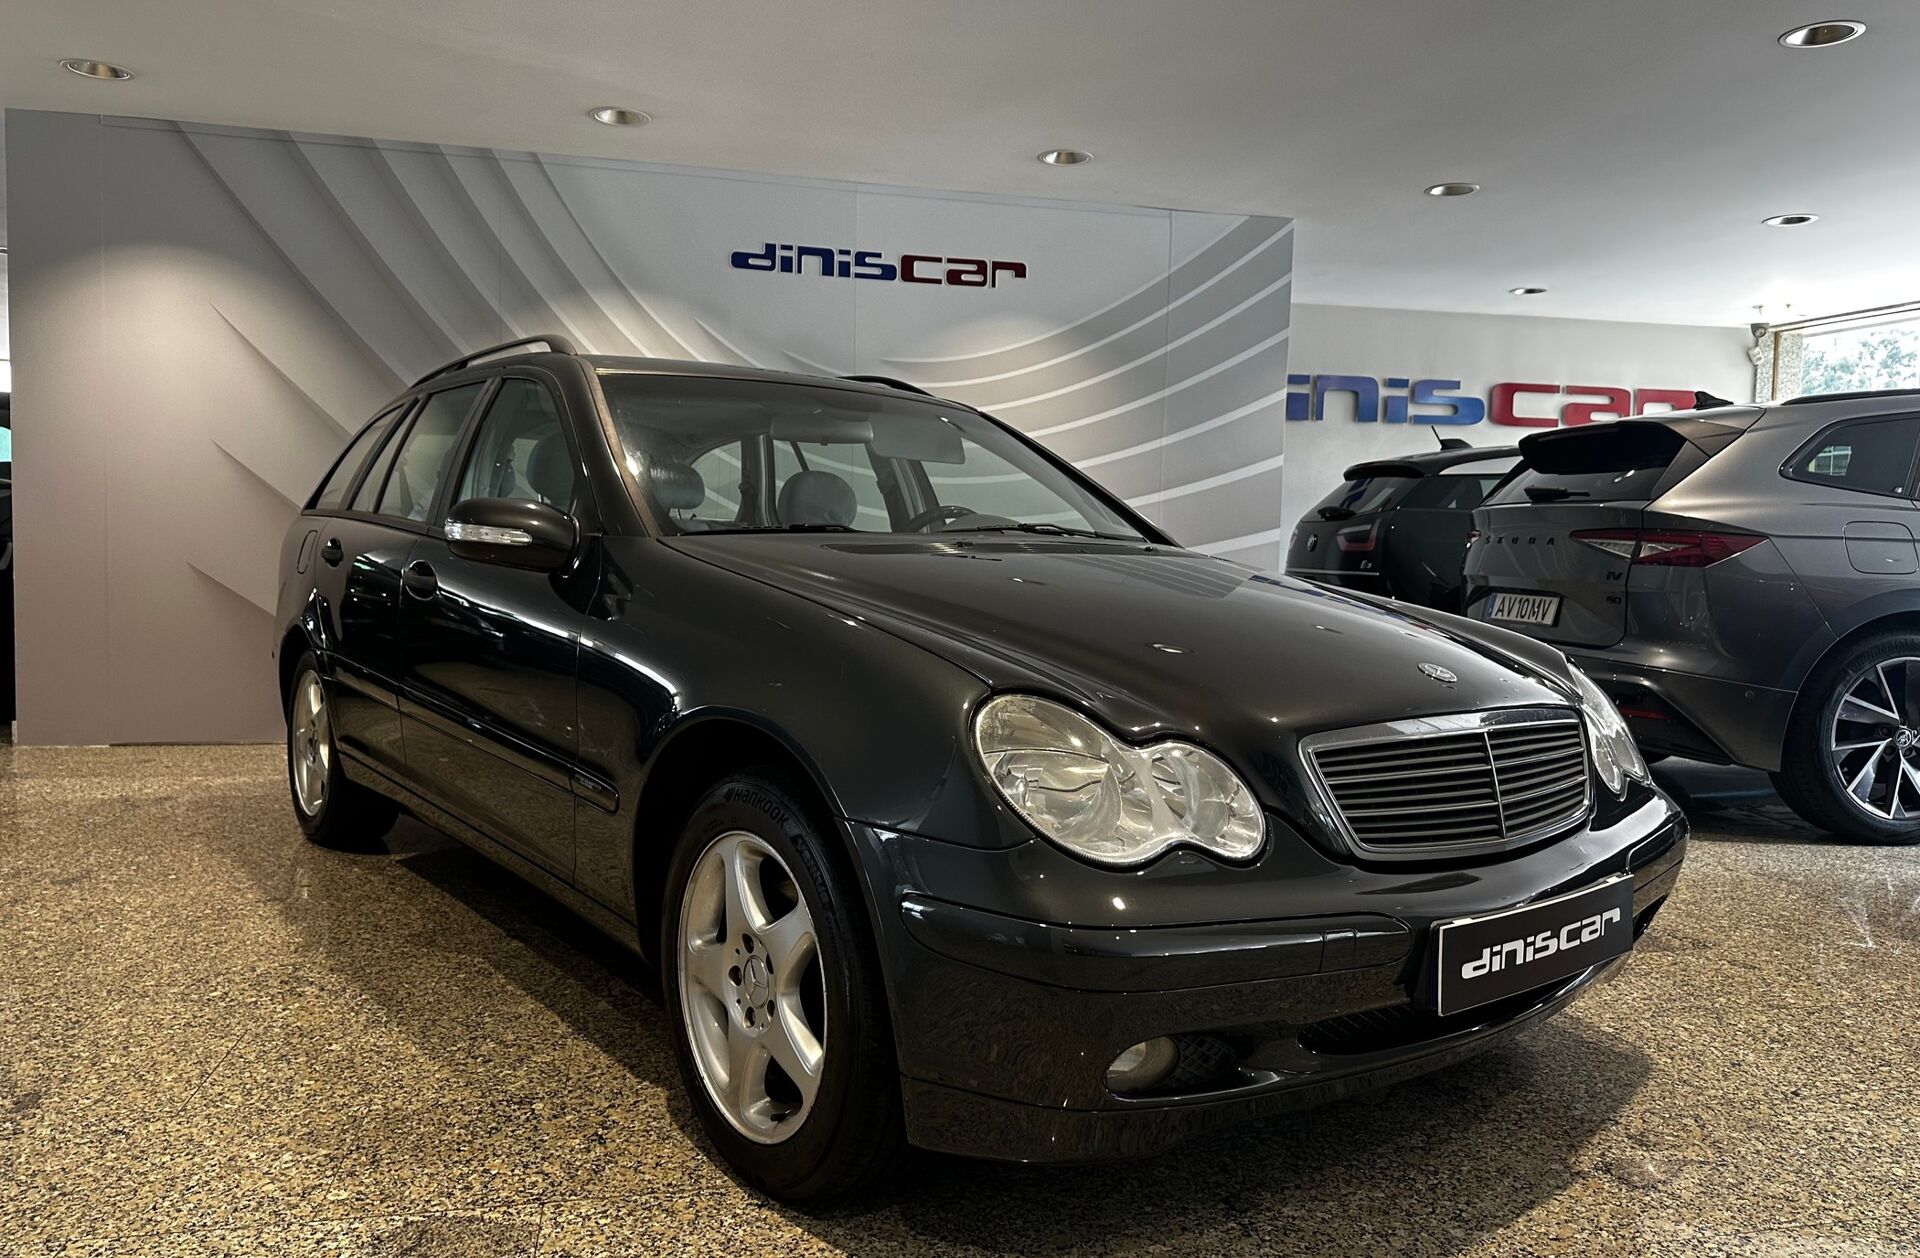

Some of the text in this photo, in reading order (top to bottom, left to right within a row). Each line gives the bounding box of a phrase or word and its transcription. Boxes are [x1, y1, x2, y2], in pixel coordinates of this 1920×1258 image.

[731, 242, 1027, 288] diniscar
[1286, 374, 1700, 427] iniscar
[1495, 596, 1552, 621] AV10MV
[1461, 907, 1621, 980] diniscar
